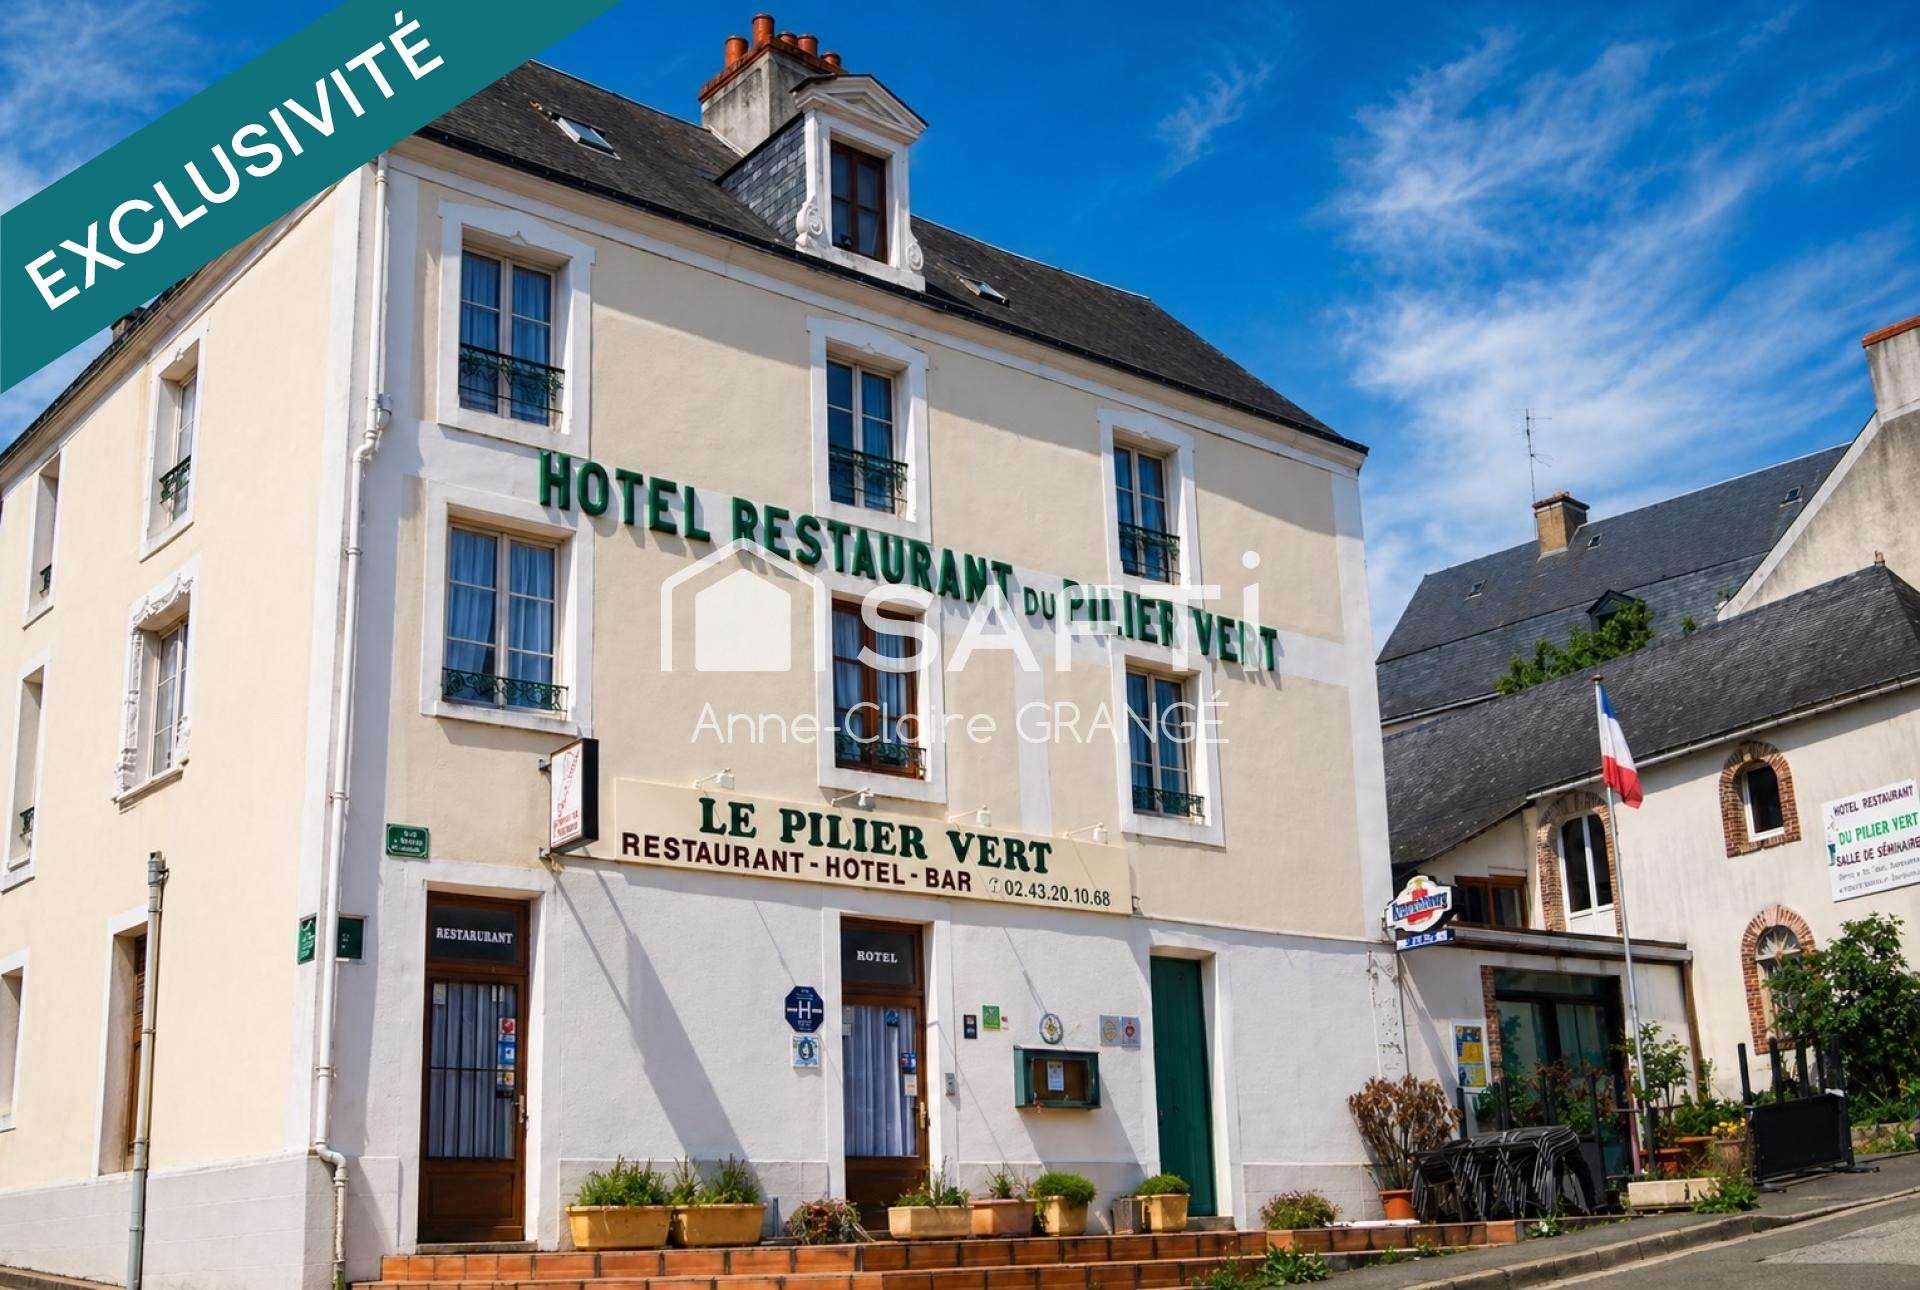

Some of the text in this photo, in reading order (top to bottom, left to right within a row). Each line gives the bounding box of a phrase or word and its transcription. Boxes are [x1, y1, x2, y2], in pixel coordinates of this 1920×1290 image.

[539, 449, 1278, 672] HOTEL RESTAURANT DU PILIER VERT
[1833, 785, 1913, 817] HOTEL RESTAURANT
[1839, 811, 1919, 846] DU PILIER VERT
[699, 797, 1053, 874] LE PILIER VERT
[1836, 851, 1861, 867] SALLE
[1864, 847, 1875, 861] DE
[622, 832, 804, 874] RESTAURANT
[826, 856, 905, 886] HOTEL
[925, 868, 972, 892] BAR
[1004, 879, 1111, 907] 02.43.20.10.68
